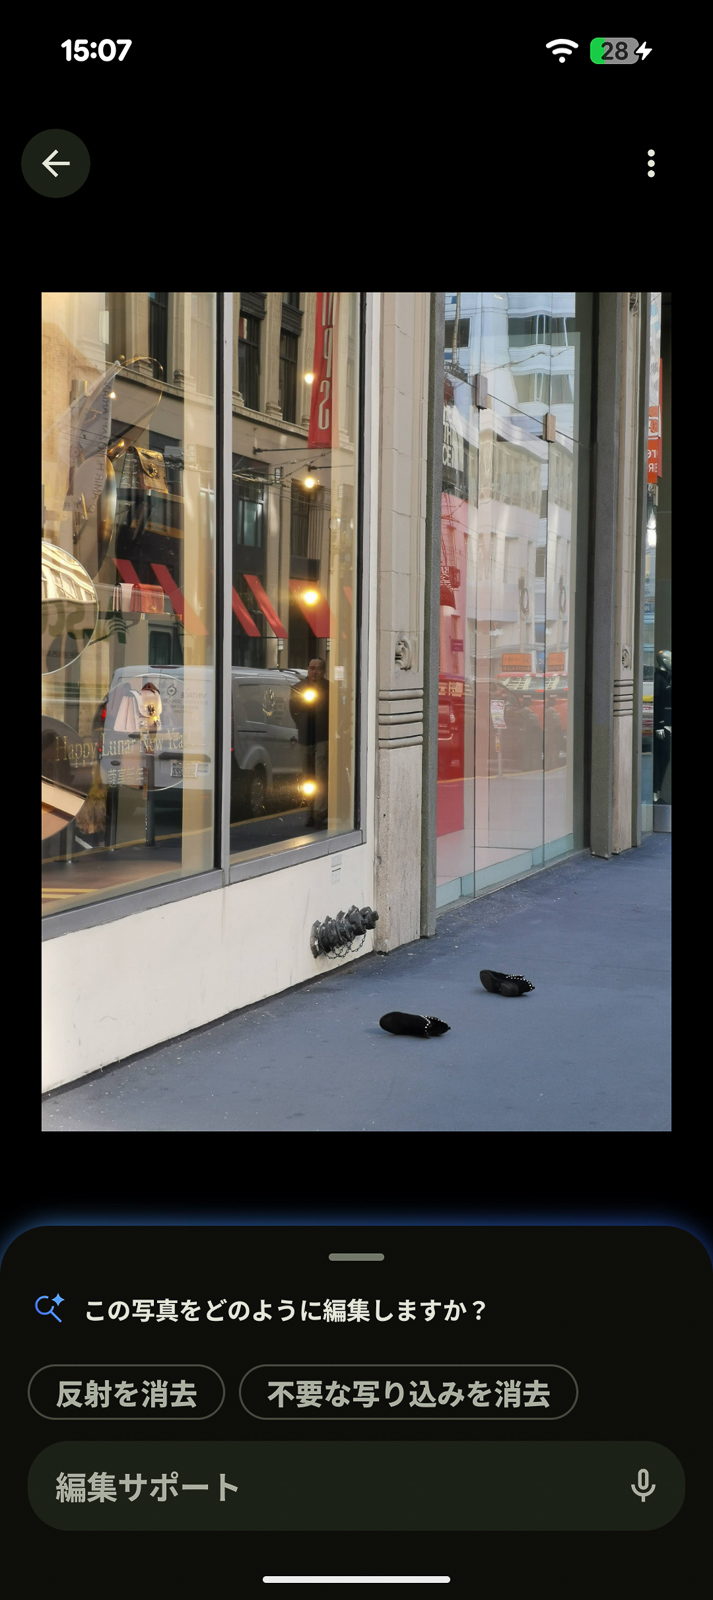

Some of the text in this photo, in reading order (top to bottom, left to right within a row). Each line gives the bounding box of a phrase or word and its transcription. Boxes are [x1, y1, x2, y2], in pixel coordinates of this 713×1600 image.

[61, 39, 132, 61] 15:07
[600, 41, 629, 61] 28
[55, 728, 187, 768] Happy Lunar New Yea
[87, 1298, 485, 1322] この写真をどのように編集しますか？
[57, 1380, 196, 1408] 反射を消去
[268, 1380, 550, 1408] 不要な写り込みを消去
[56, 1471, 238, 1502] 編集サポート
